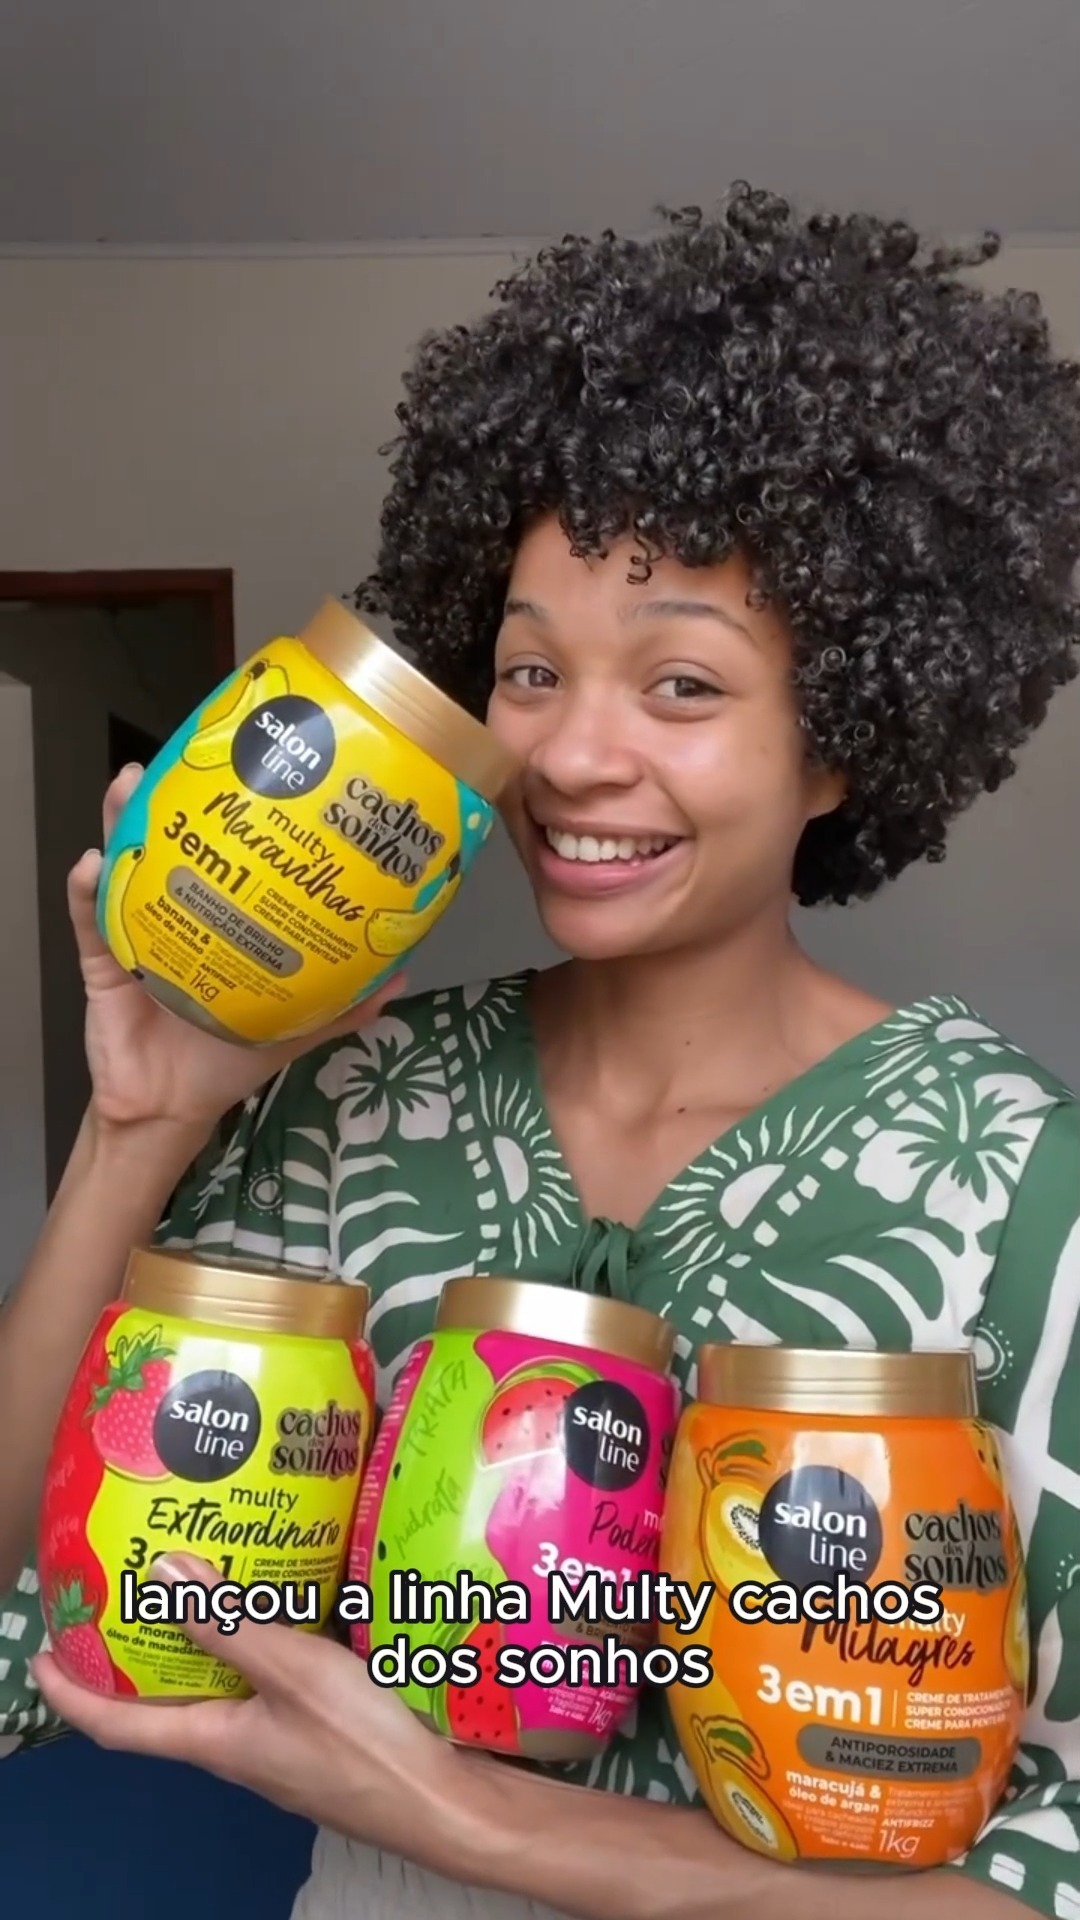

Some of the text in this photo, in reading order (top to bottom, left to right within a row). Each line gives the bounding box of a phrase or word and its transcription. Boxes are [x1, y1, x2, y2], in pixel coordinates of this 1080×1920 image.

[255, 711, 322, 770] salon
[261, 745, 305, 790] line
[267, 806, 335, 863] multy
[346, 778, 443, 855] cachos
[368, 817, 388, 836] dos
[203, 792, 365, 921] Maravilhas
[323, 803, 423, 884] sonhos
[144, 901, 163, 921] óleo
[163, 918, 177, 933] de
[157, 895, 211, 945] banana &
[174, 886, 183, 897] &
[183, 893, 237, 939] NUTRIÇÃO
[235, 933, 284, 971] EXTREMA
[189, 882, 285, 957] BANHO DE BRILHO
[253, 904, 340, 965] CREME PARA PENTEAR
[259, 895, 353, 961] SUPER CONDICIONADOR
[266, 888, 359, 954] CREME DE TRATAMENTO
[189, 969, 221, 1003] 1kg
[169, 1399, 250, 1433] salon
[280, 1405, 360, 1438] cachos
[572, 1405, 642, 1446] salon
[194, 1427, 245, 1461] line
[272, 1439, 359, 1476] sonhos
[599, 1436, 640, 1473] line
[229, 1487, 300, 1513] multy
[147, 1497, 341, 1550] Extraordinário
[773, 1500, 868, 1538] salon
[905, 1503, 1002, 1544] cachos
[124, 1536, 234, 1580] 31
[254, 1557, 285, 1567] CREME
[286, 1558, 297, 1568] DE
[810, 1532, 867, 1572] line
[904, 1540, 1009, 1590] sonhos
[943, 1543, 964, 1556] dos
[252, 1569, 281, 1578] SUPER
[106, 1627, 130, 1643] óleo
[131, 1635, 146, 1647] de
[800, 1610, 976, 1687] Milagres
[208, 1669, 242, 1693] 1kg
[757, 1664, 882, 1726] 3em1
[907, 1692, 945, 1704] CREME
[946, 1693, 960, 1704] DE
[588, 1701, 613, 1732] 1kg
[904, 1718, 942, 1731] CREME
[944, 1719, 971, 1730] PARA
[905, 1705, 942, 1717] SUPER
[825, 1751, 959, 1775] & MACIEZ EXTREMA
[830, 1736, 956, 1760] ANTIPOROSIDADE
[786, 1770, 882, 1800] maracujá &
[788, 1786, 818, 1803] óleo
[820, 1793, 838, 1808] de
[879, 1828, 921, 1859] 1kg
